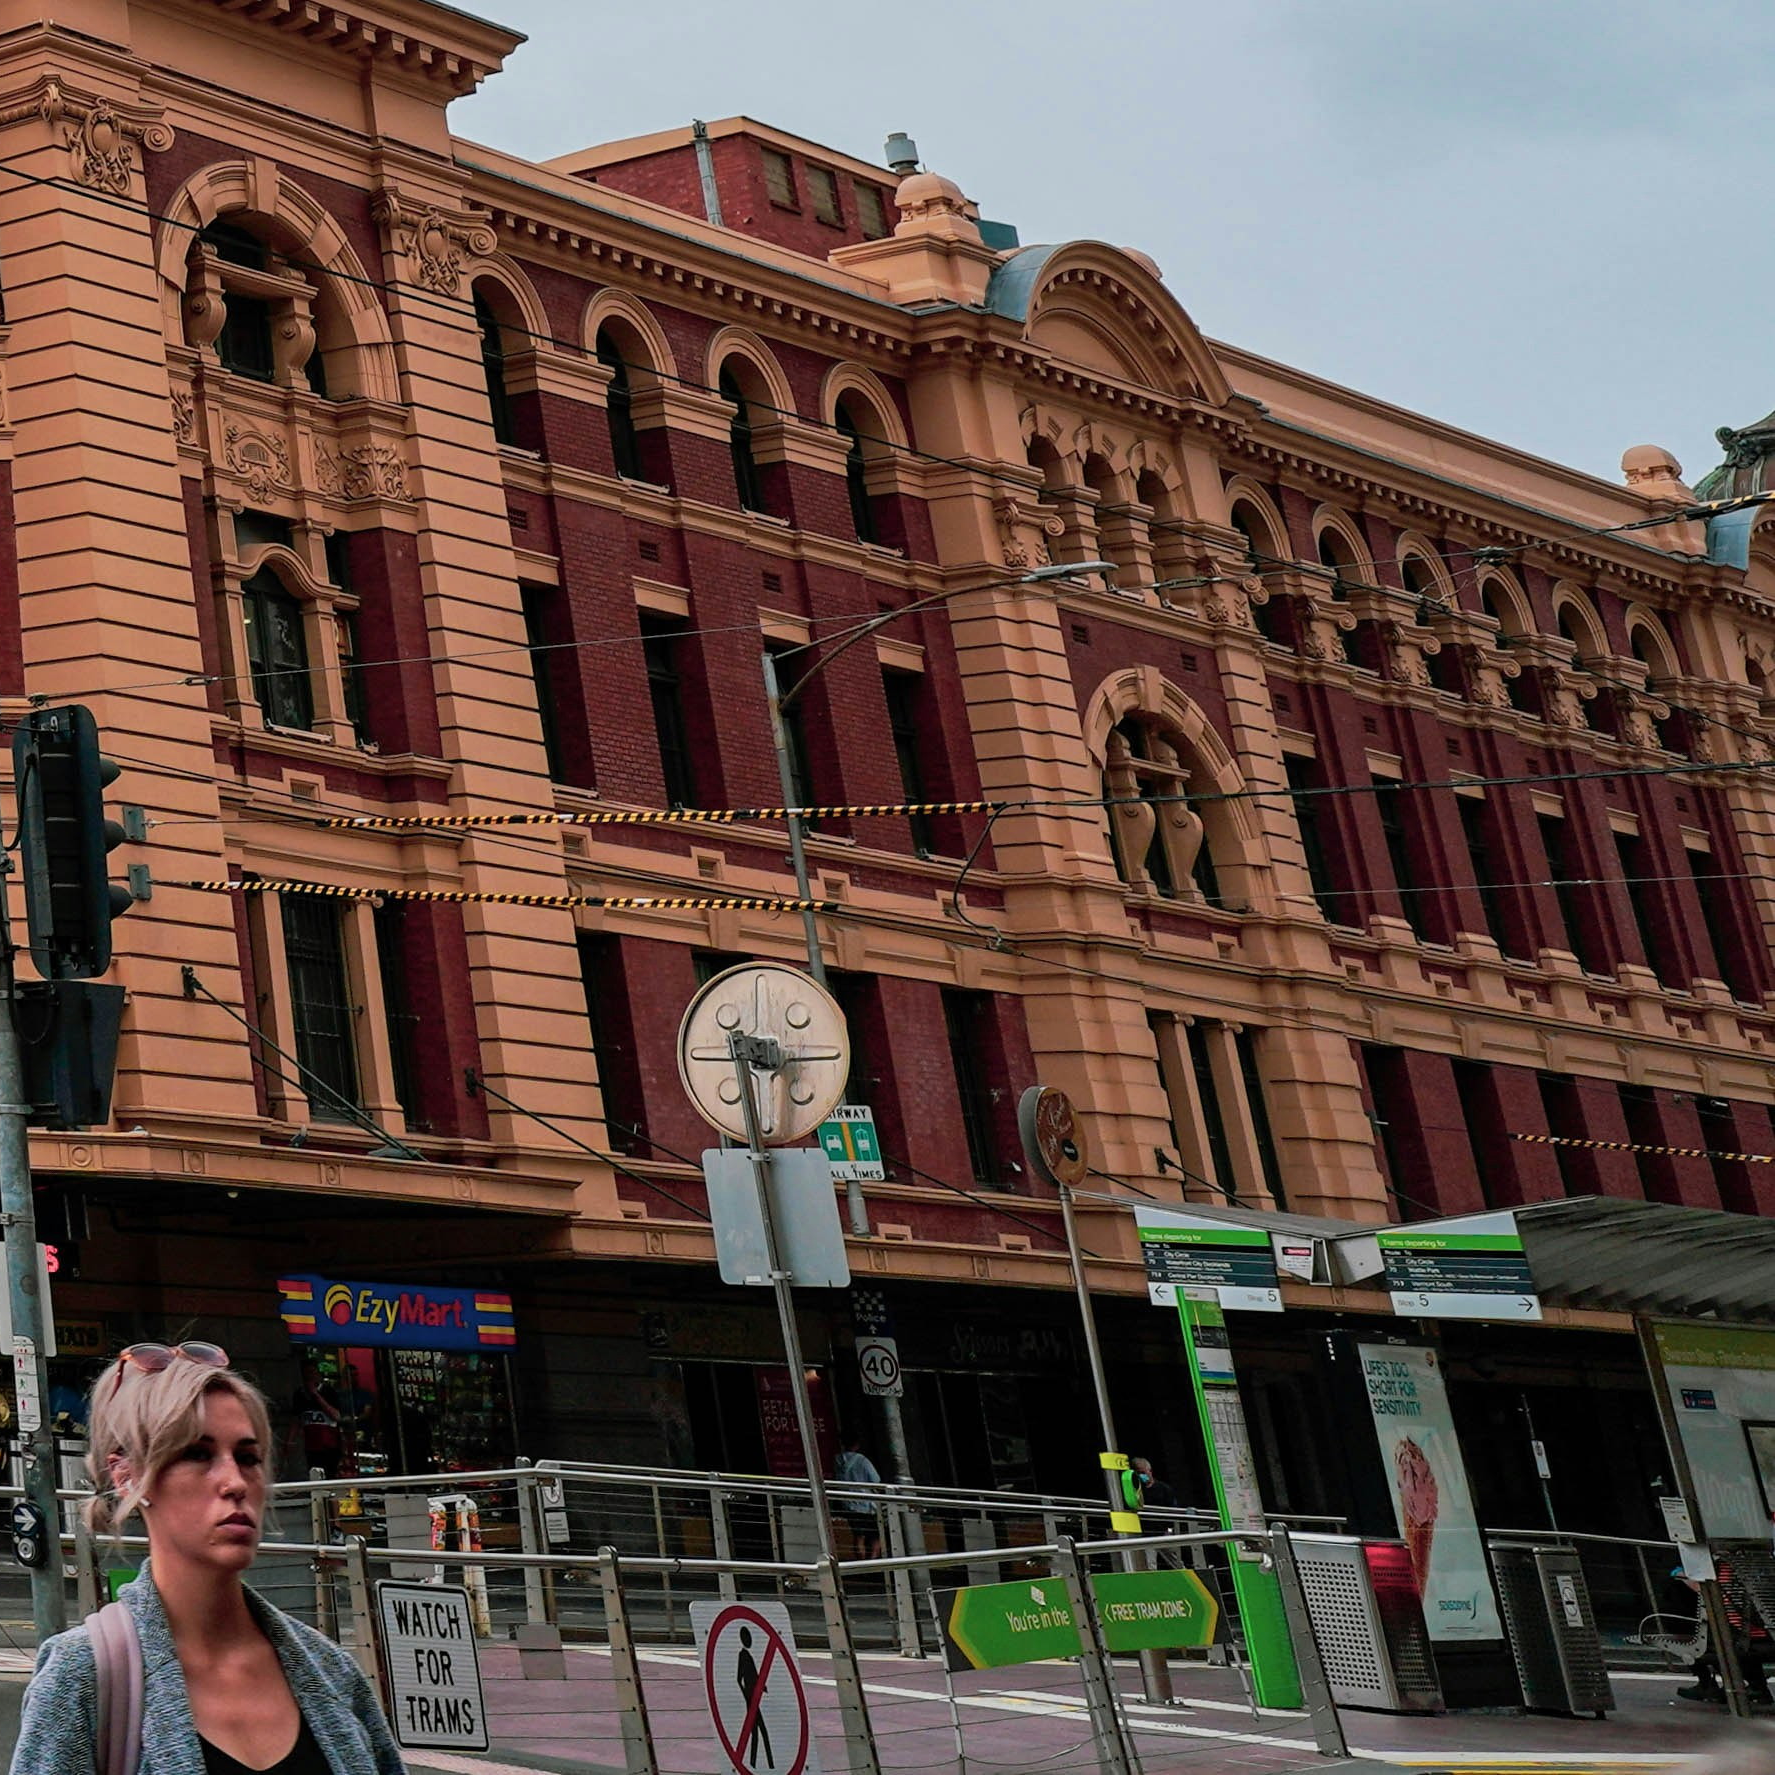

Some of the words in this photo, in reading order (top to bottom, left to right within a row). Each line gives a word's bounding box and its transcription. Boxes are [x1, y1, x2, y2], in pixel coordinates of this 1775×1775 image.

[852, 1169, 883, 1180] TIMES
[1267, 1289, 1277, 1302] 5
[1419, 1293, 1429, 1307] 5
[355, 1290, 464, 1333] EzyMart
[856, 1313, 887, 1323] Police
[865, 1355, 895, 1378] 40
[1392, 1362, 1410, 1378] TOO
[1368, 1378, 1397, 1395] SHORT
[1398, 1381, 1417, 1397] FOR
[1373, 1398, 1422, 1417] SENSITIVITY
[392, 1600, 462, 1639] WATCH
[1005, 1609, 1040, 1633] You're
[1041, 1607, 1052, 1628] in
[1053, 1608, 1071, 1627] the
[1111, 1602, 1136, 1621] FREE
[1137, 1601, 1161, 1620] TRAM
[1162, 1600, 1186, 1619] ZONE
[414, 1649, 455, 1686] FOR
[406, 1695, 476, 1736] TRAMS
